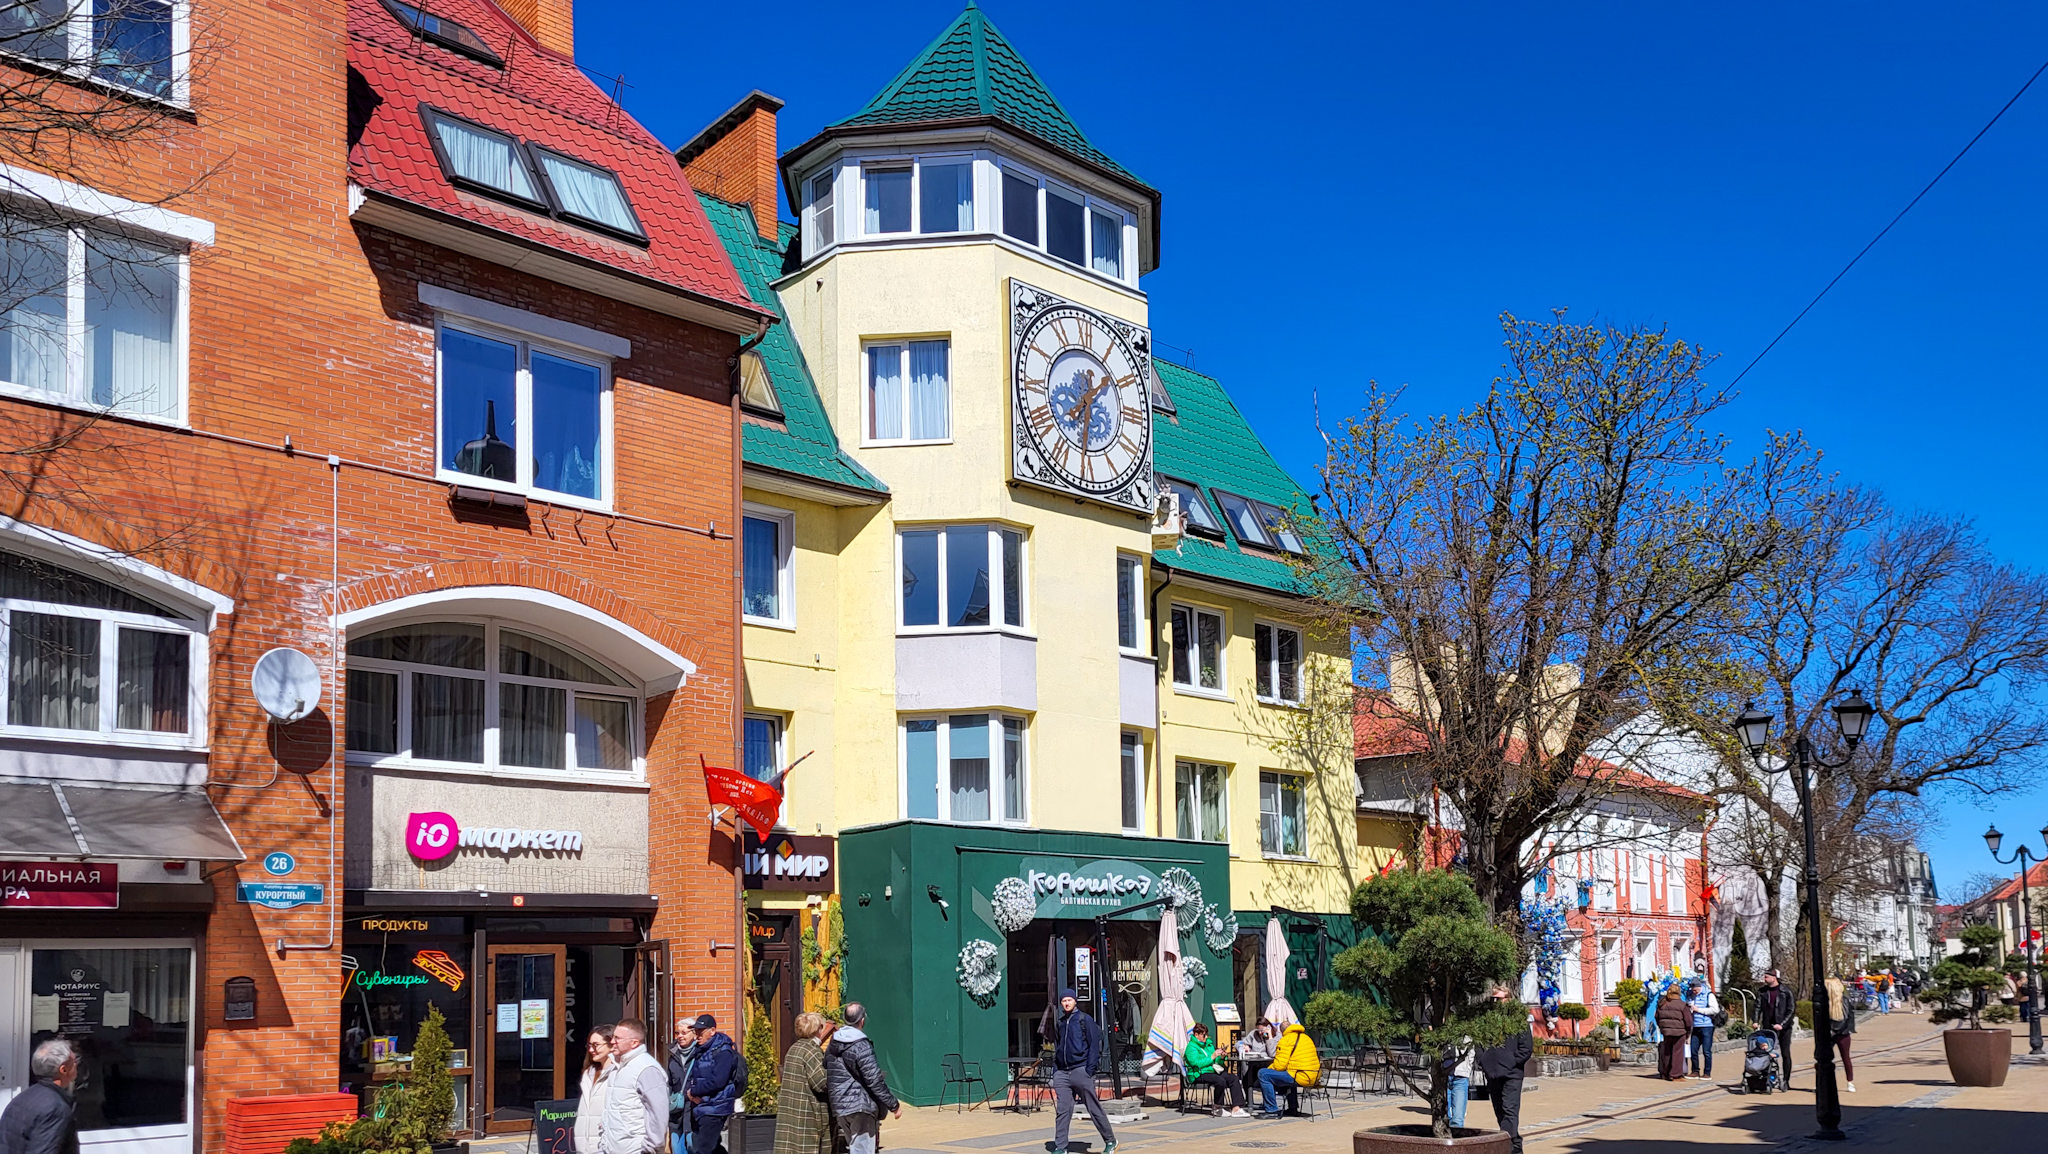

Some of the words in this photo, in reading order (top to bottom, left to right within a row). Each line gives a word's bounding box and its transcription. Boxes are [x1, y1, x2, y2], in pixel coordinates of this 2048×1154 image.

[271, 857, 287, 870] 26
[774, 854, 829, 877] МИР
[2, 868, 101, 883] ИАЛЬНАЯ
[0, 886, 30, 900] РА
[255, 890, 306, 900] КУРОРТНЫЙ
[1060, 896, 1101, 906] БАЛТИЙСКАЯ
[1101, 898, 1121, 906] КУХНЯ
[362, 920, 428, 932] ПРОДУКТЫ
[1117, 960, 1122, 971] Я
[1122, 960, 1130, 971] НА
[1130, 960, 1145, 971] МОРЕ
[356, 970, 429, 990] Сувениры
[1112, 971, 1117, 981] Я
[1117, 971, 1126, 981] ЕМ
[1126, 971, 1152, 981] КОРЮШКУ
[54, 983, 101, 991] НОТАРИУС
[565, 959, 576, 1043] ТАБАК
